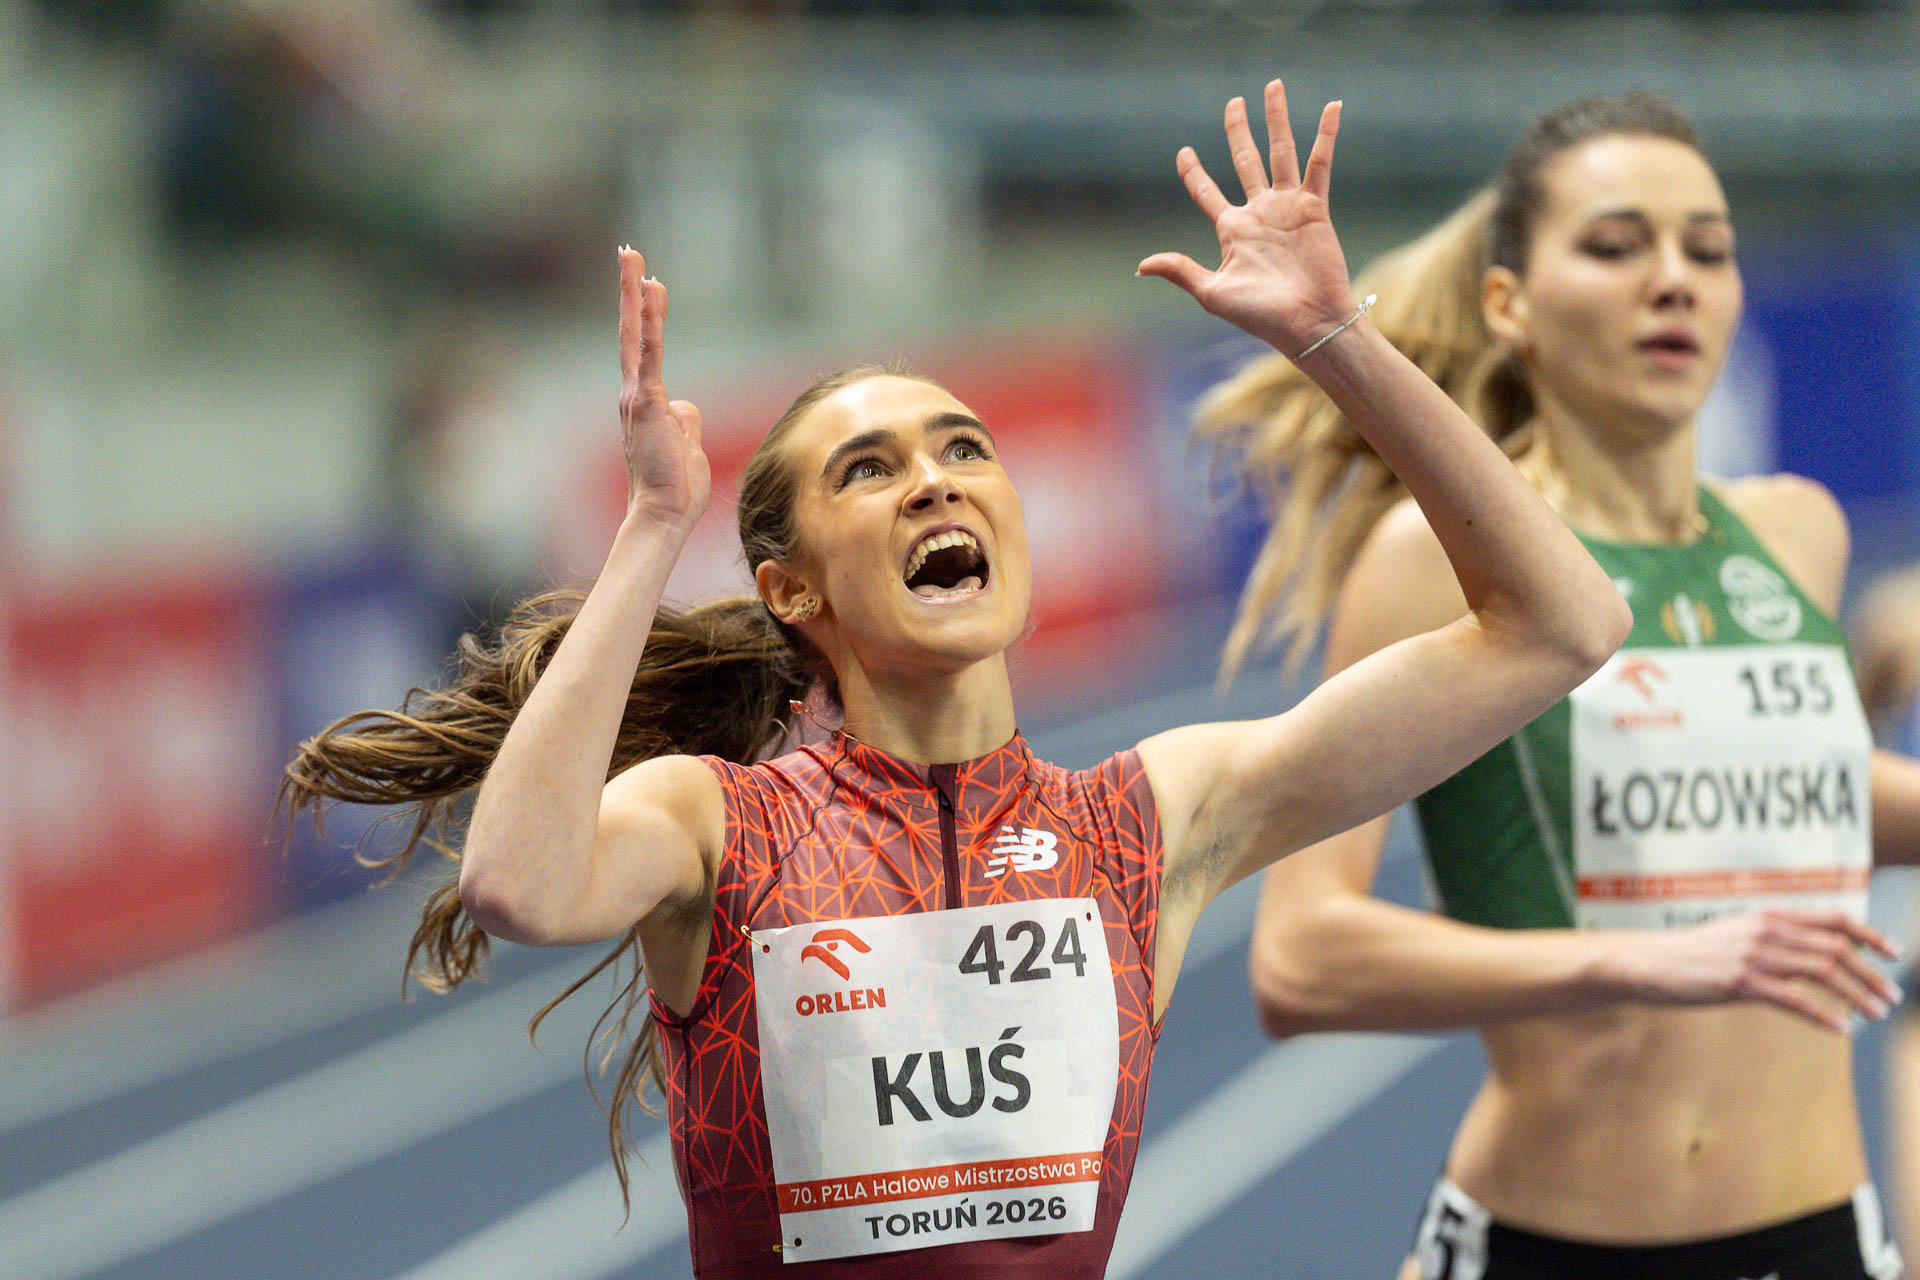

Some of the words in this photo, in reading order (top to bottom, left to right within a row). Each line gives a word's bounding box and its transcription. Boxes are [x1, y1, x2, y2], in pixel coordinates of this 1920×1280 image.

[1738, 660, 1835, 718] 155
[1590, 764, 1857, 835] ŁOZOWSKA
[958, 917, 1088, 985] 424
[795, 988, 887, 1017] ORLEN
[871, 1026, 1032, 1127] KUŚ
[790, 1186, 817, 1206] 70.
[821, 1181, 868, 1203] PZLA
[873, 1175, 950, 1197] Halowe
[954, 1161, 1076, 1187] Mistrzostwa
[1081, 1155, 1103, 1175] Po
[864, 1197, 977, 1239] TORUŃ
[985, 1196, 1067, 1226] 2026
